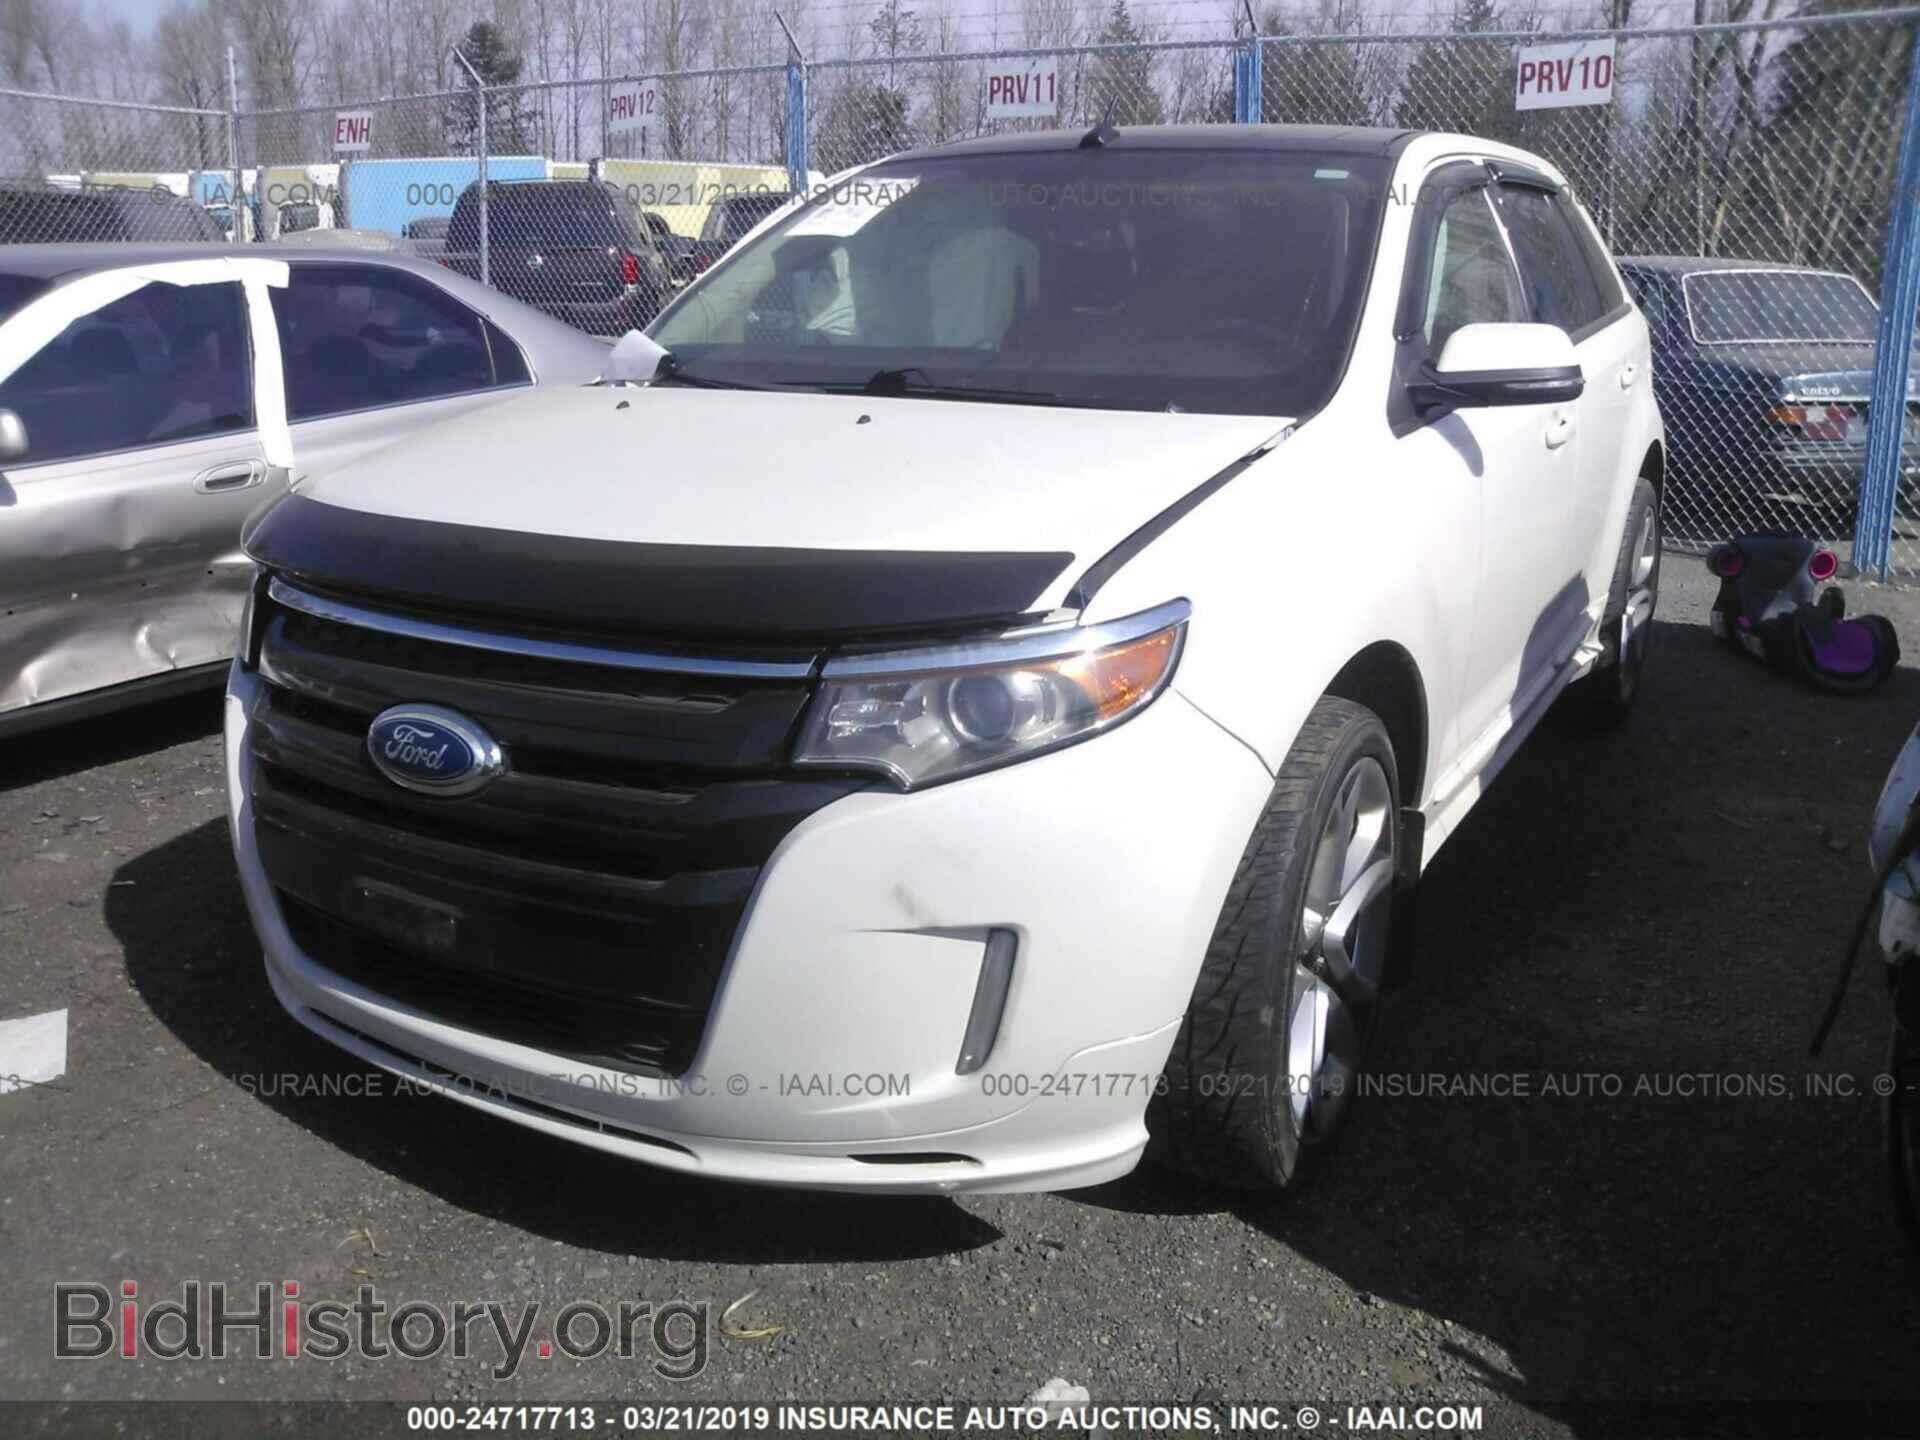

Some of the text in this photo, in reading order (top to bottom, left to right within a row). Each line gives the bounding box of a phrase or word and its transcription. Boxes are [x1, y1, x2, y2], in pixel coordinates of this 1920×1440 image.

[989, 72, 1055, 105] PRV11
[1519, 54, 1612, 95] PRV10
[610, 89, 655, 122] PRV12
[336, 117, 371, 144] ENH
[385, 724, 448, 769] Ford
